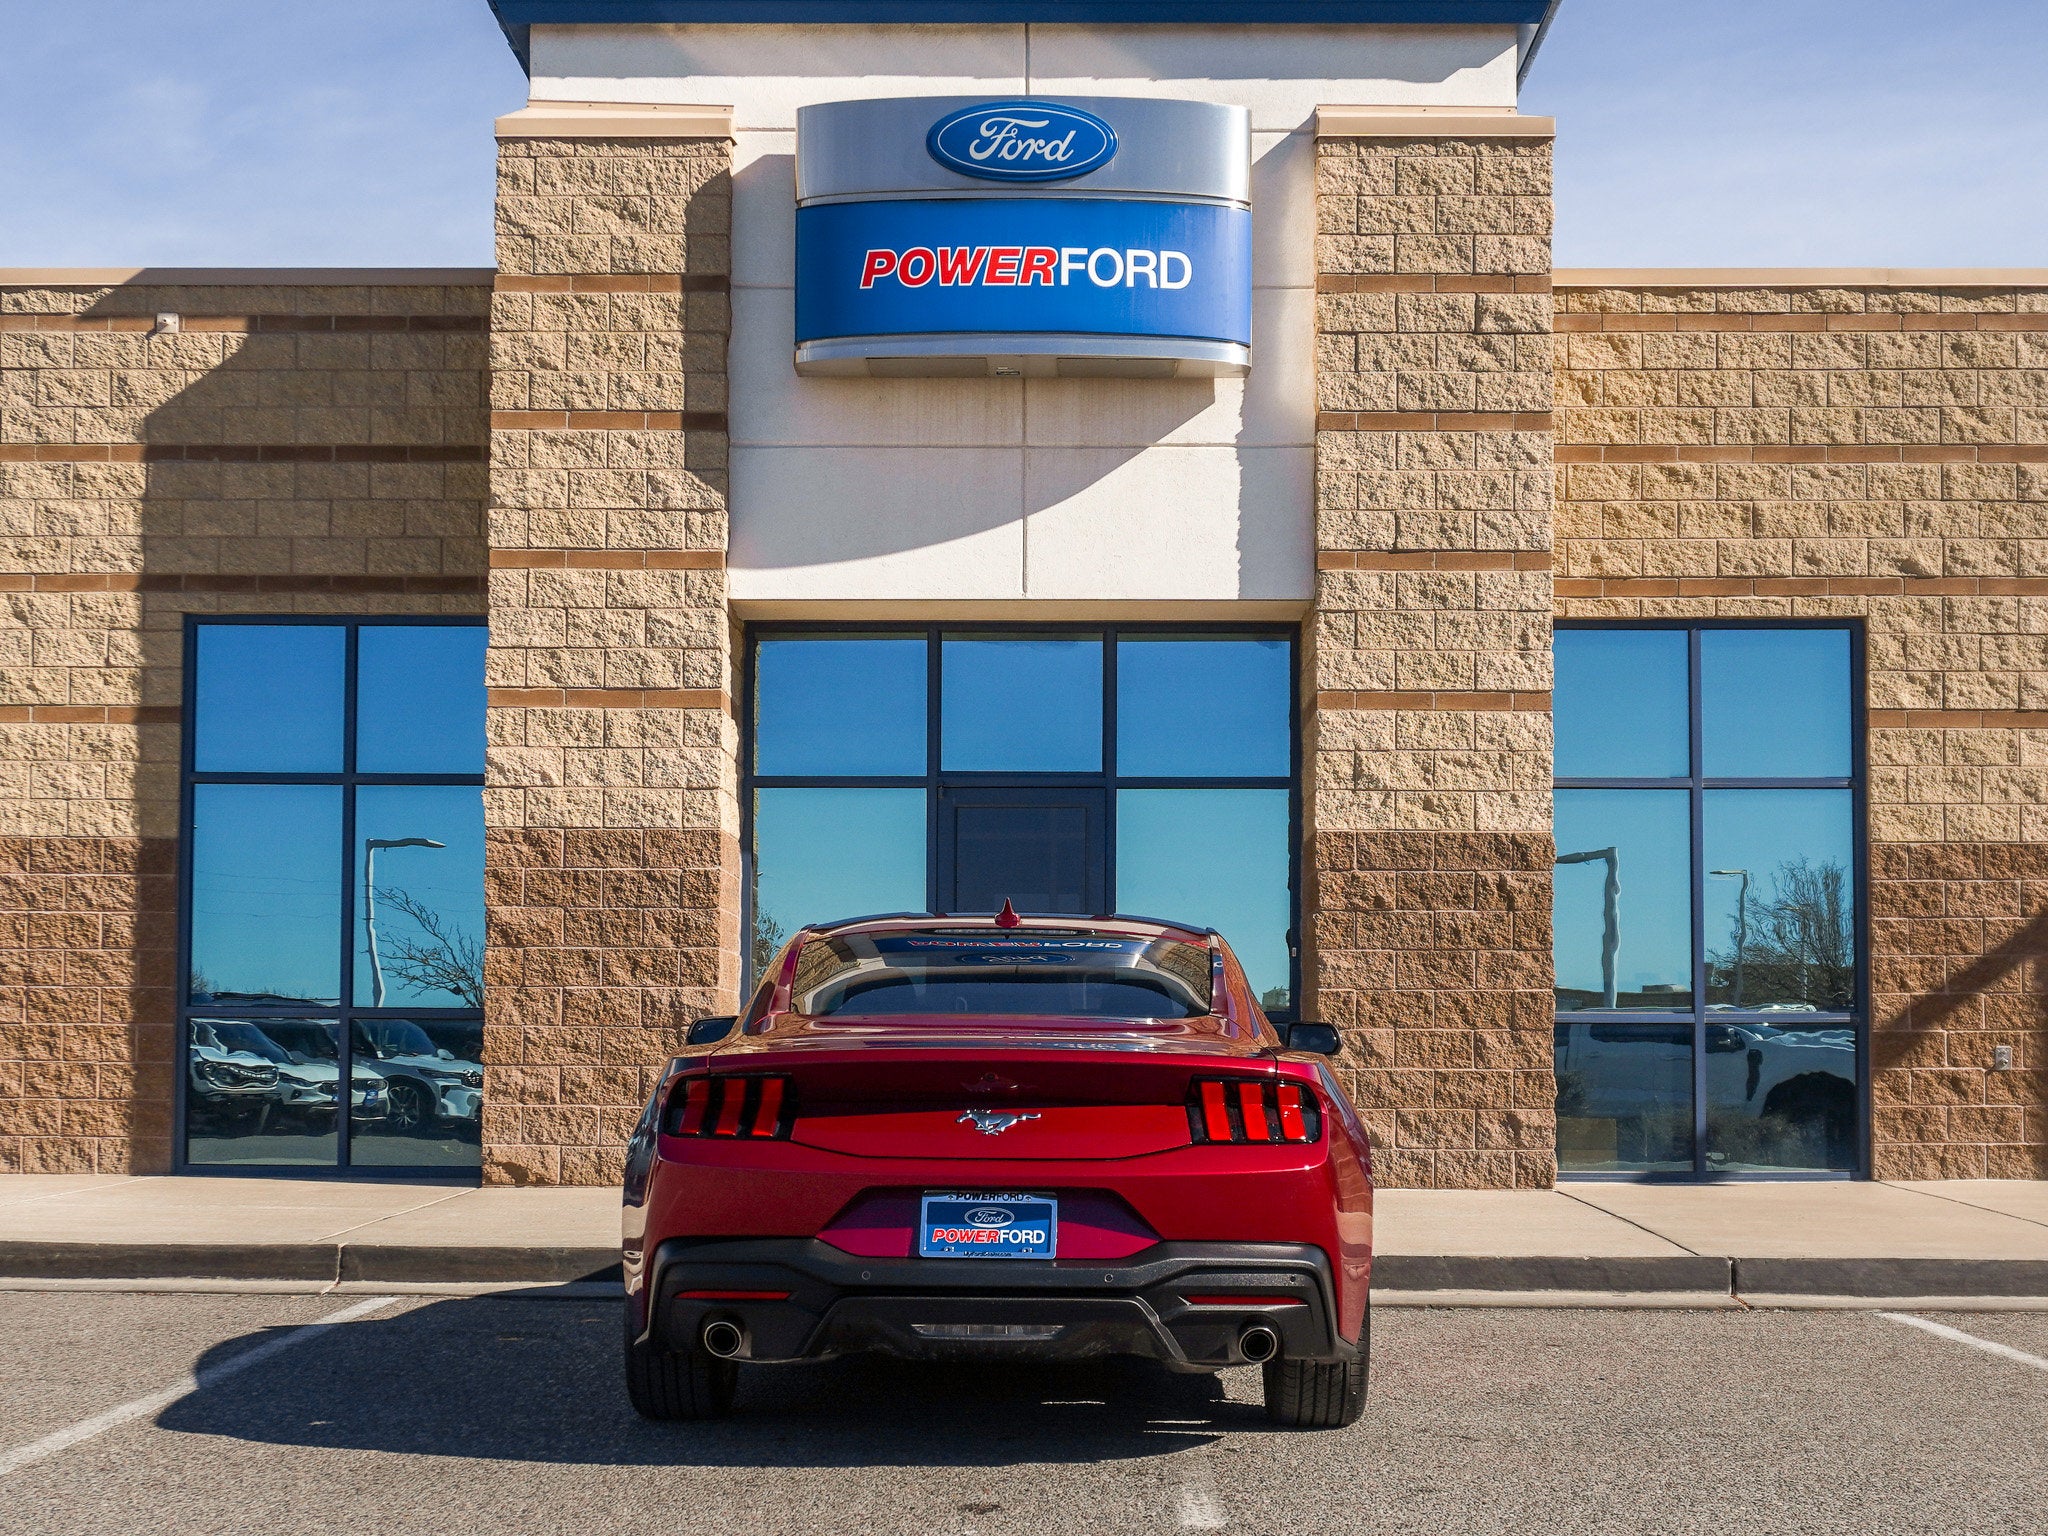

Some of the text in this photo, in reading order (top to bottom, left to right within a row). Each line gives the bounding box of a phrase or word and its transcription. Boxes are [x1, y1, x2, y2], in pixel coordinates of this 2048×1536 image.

[968, 116, 1077, 163] Ford
[859, 246, 1193, 290] POWERFORD
[956, 1192, 1025, 1202] POWERFORD
[974, 1210, 1004, 1223] Ford
[932, 1228, 1045, 1244] POWERFORD
